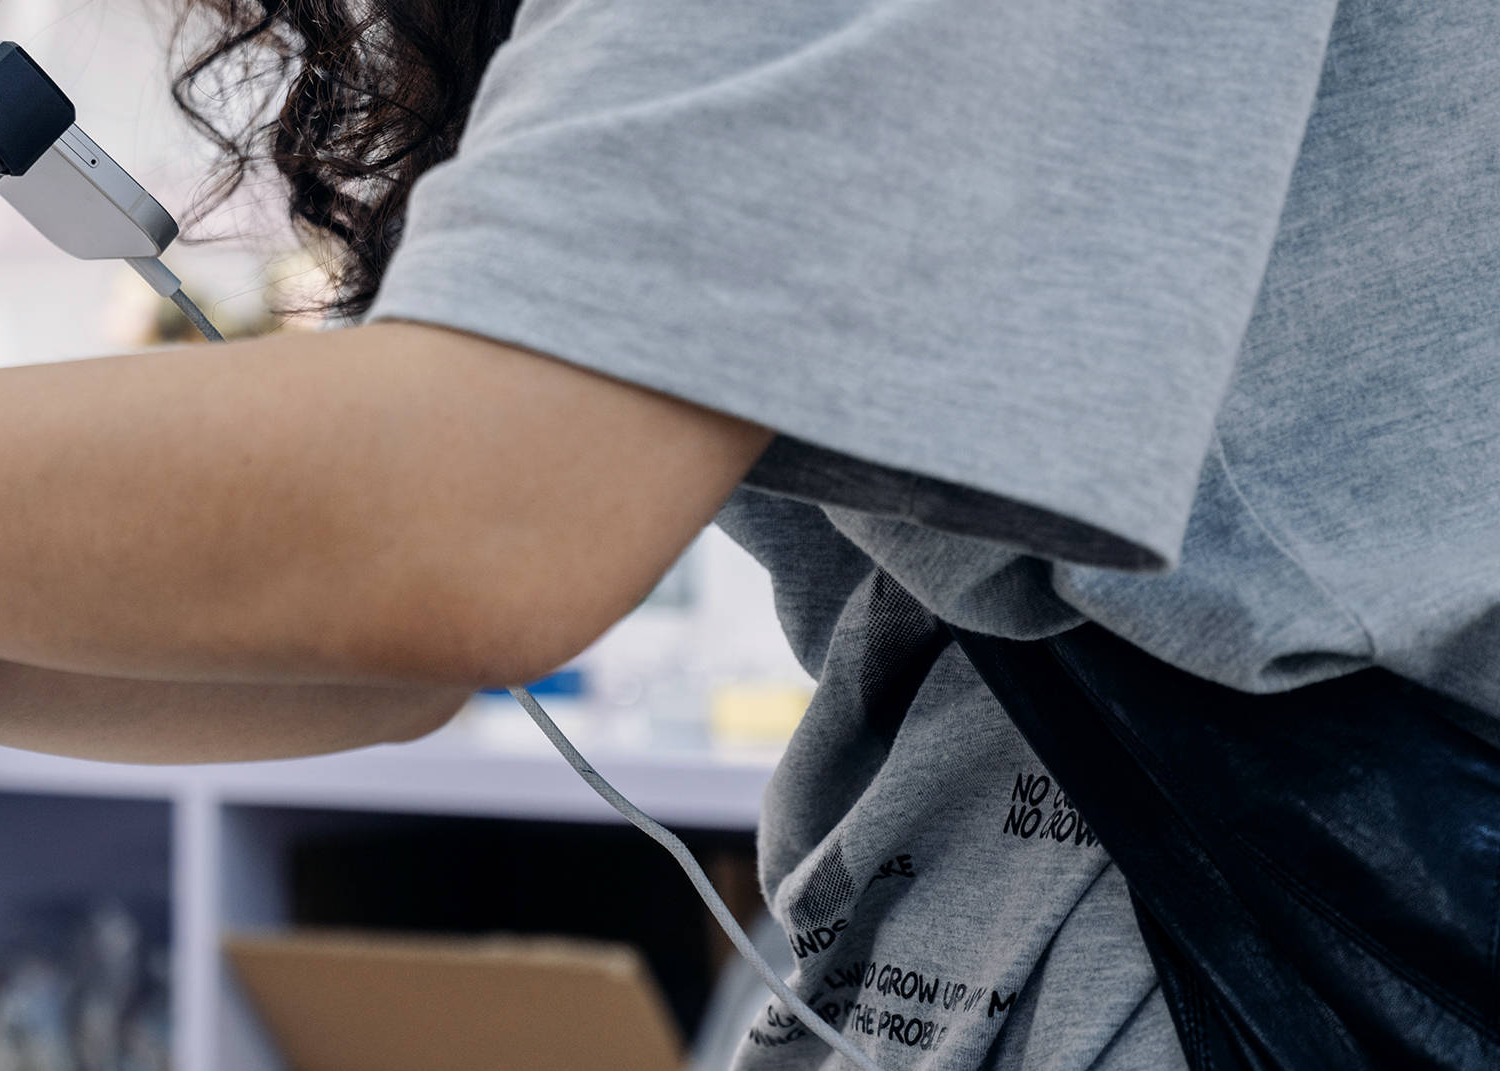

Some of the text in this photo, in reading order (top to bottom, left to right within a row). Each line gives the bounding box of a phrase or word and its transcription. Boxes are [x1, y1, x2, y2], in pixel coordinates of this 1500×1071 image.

[1011, 773, 1050, 807] NO
[1003, 805, 1100, 848] NO CROW
[876, 964, 940, 1005] GROW
[943, 981, 968, 1012] UP
